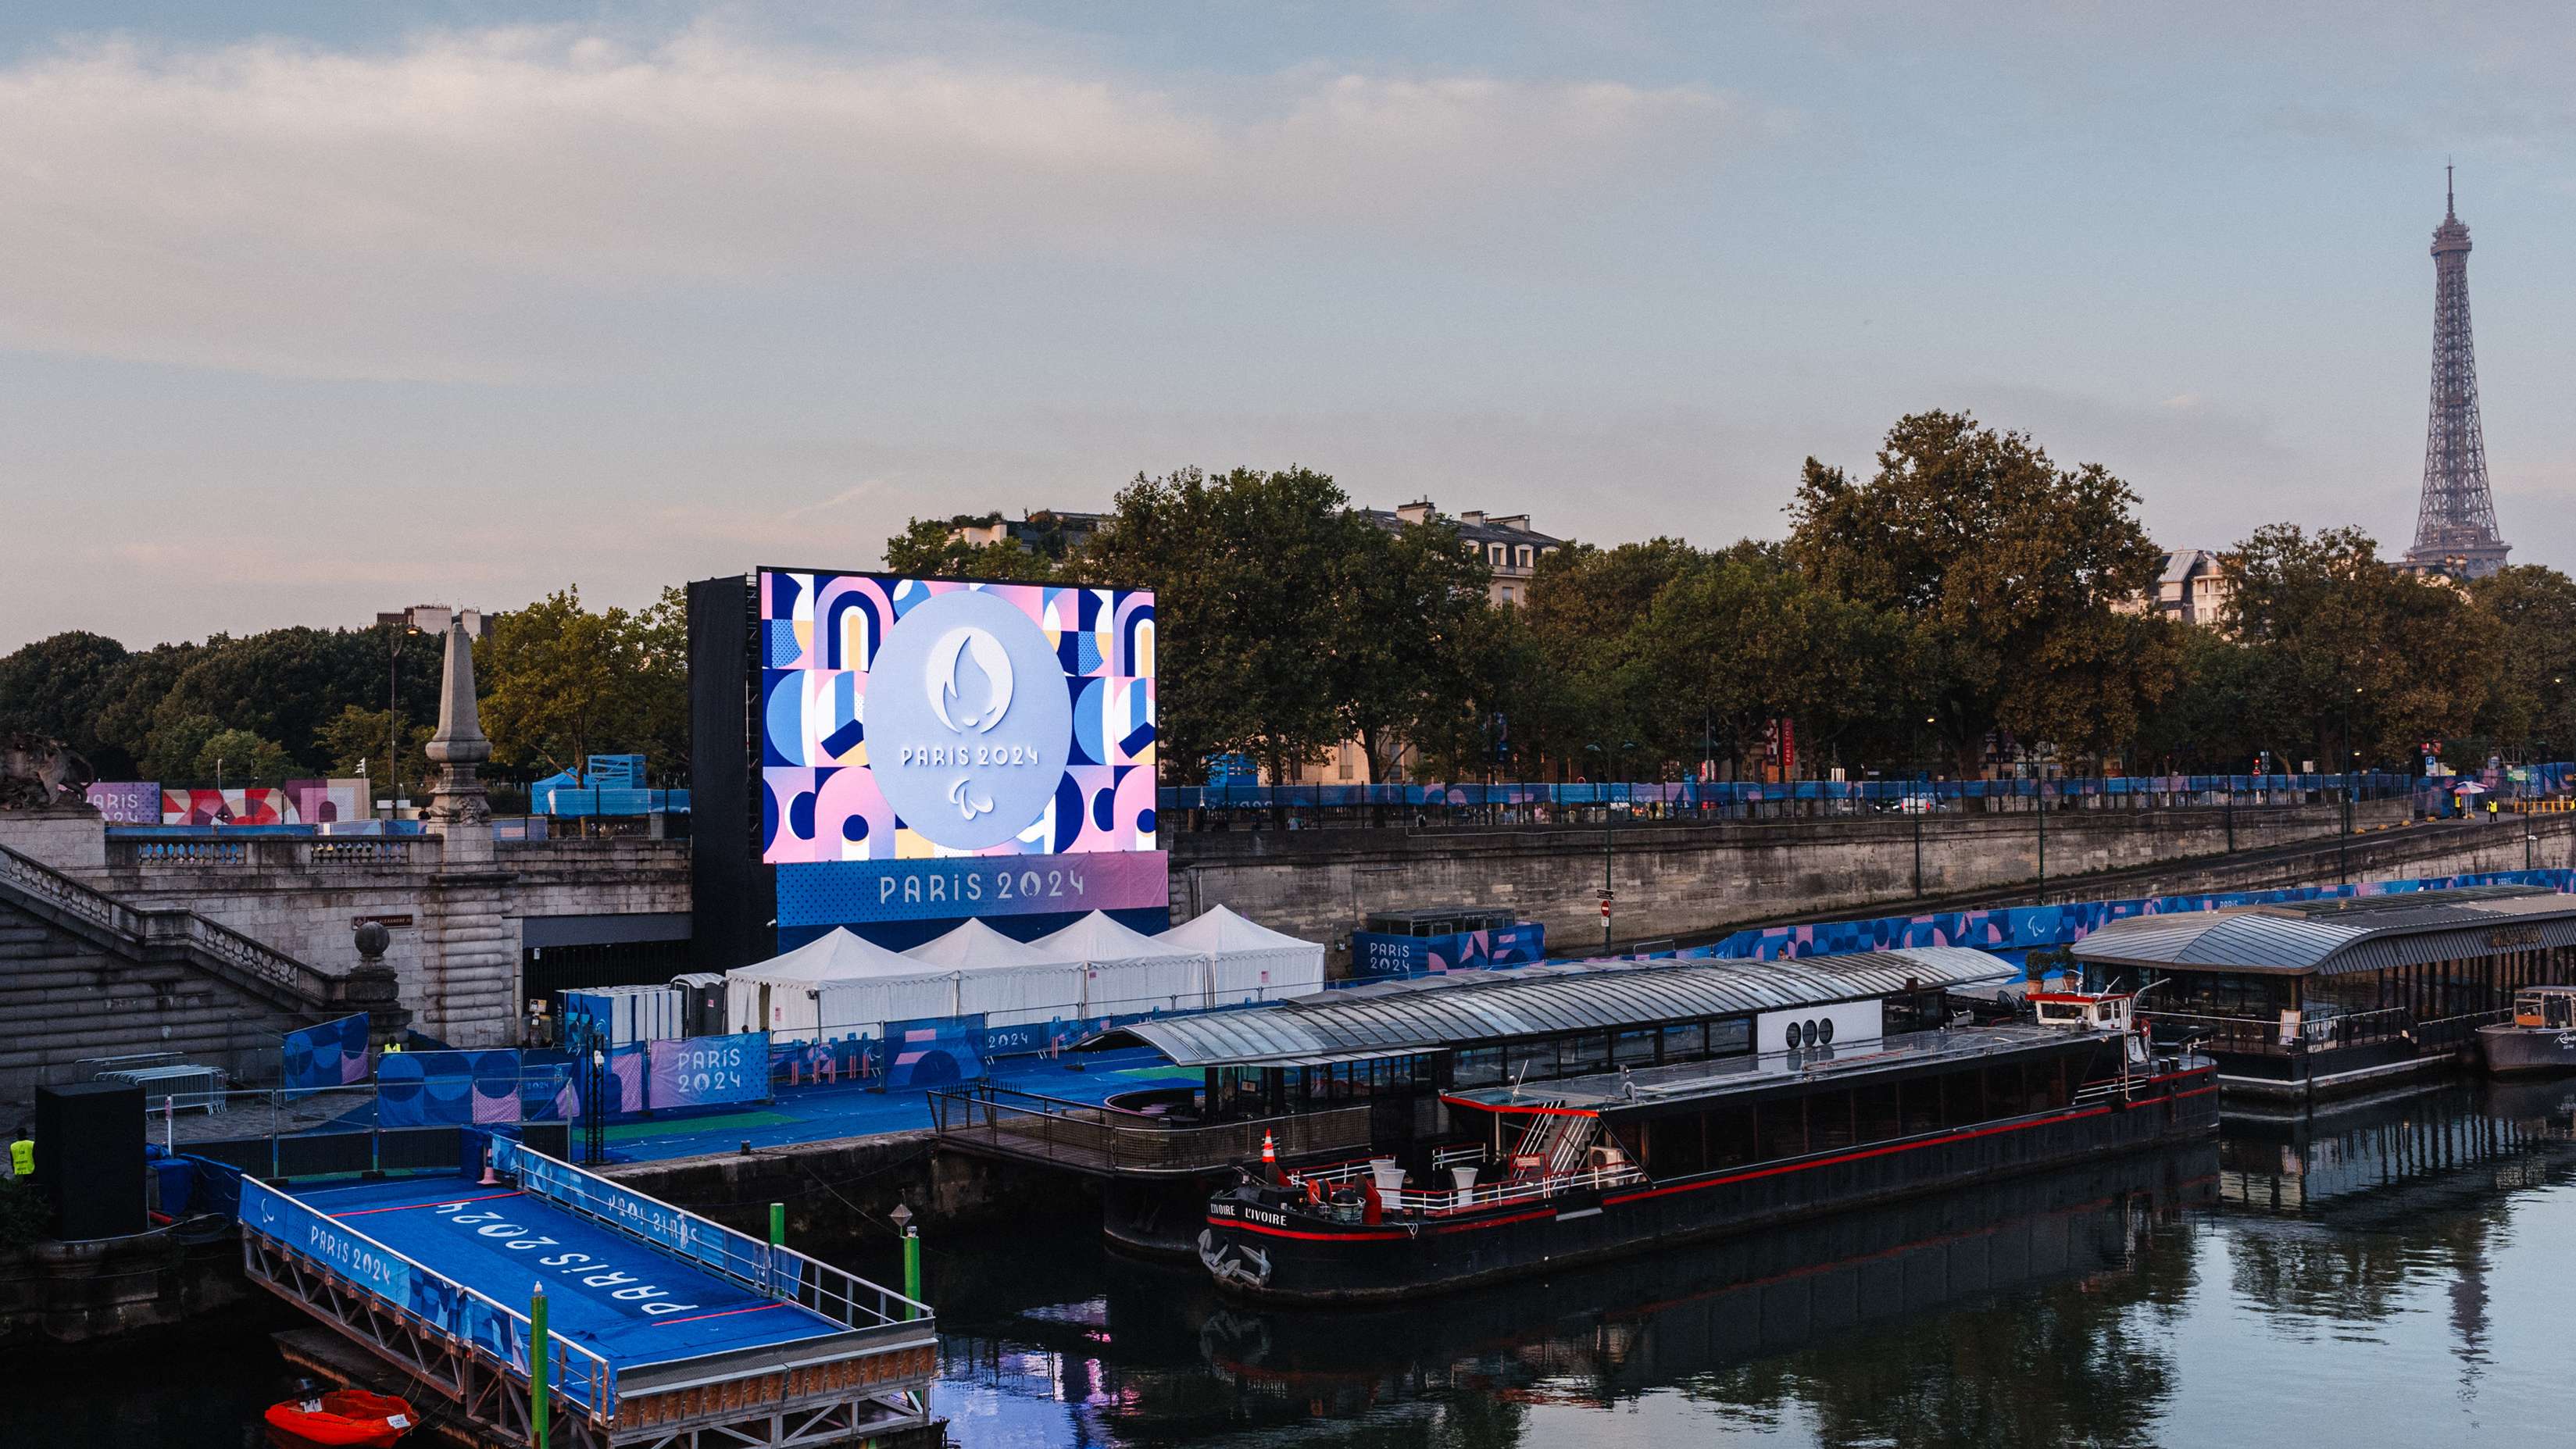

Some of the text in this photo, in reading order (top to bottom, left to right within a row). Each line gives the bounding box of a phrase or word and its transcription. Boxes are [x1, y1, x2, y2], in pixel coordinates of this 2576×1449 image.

[978, 746, 1039, 766] 2024
[997, 870, 1084, 898] 2024
[1370, 958, 1409, 972] 2024
[988, 1033, 1028, 1048] 2024
[678, 1071, 741, 1094] 2024
[436, 1201, 560, 1250] 2024
[1245, 1207, 1288, 1226] L'IVOIRE
[352, 1248, 391, 1285] 2024
